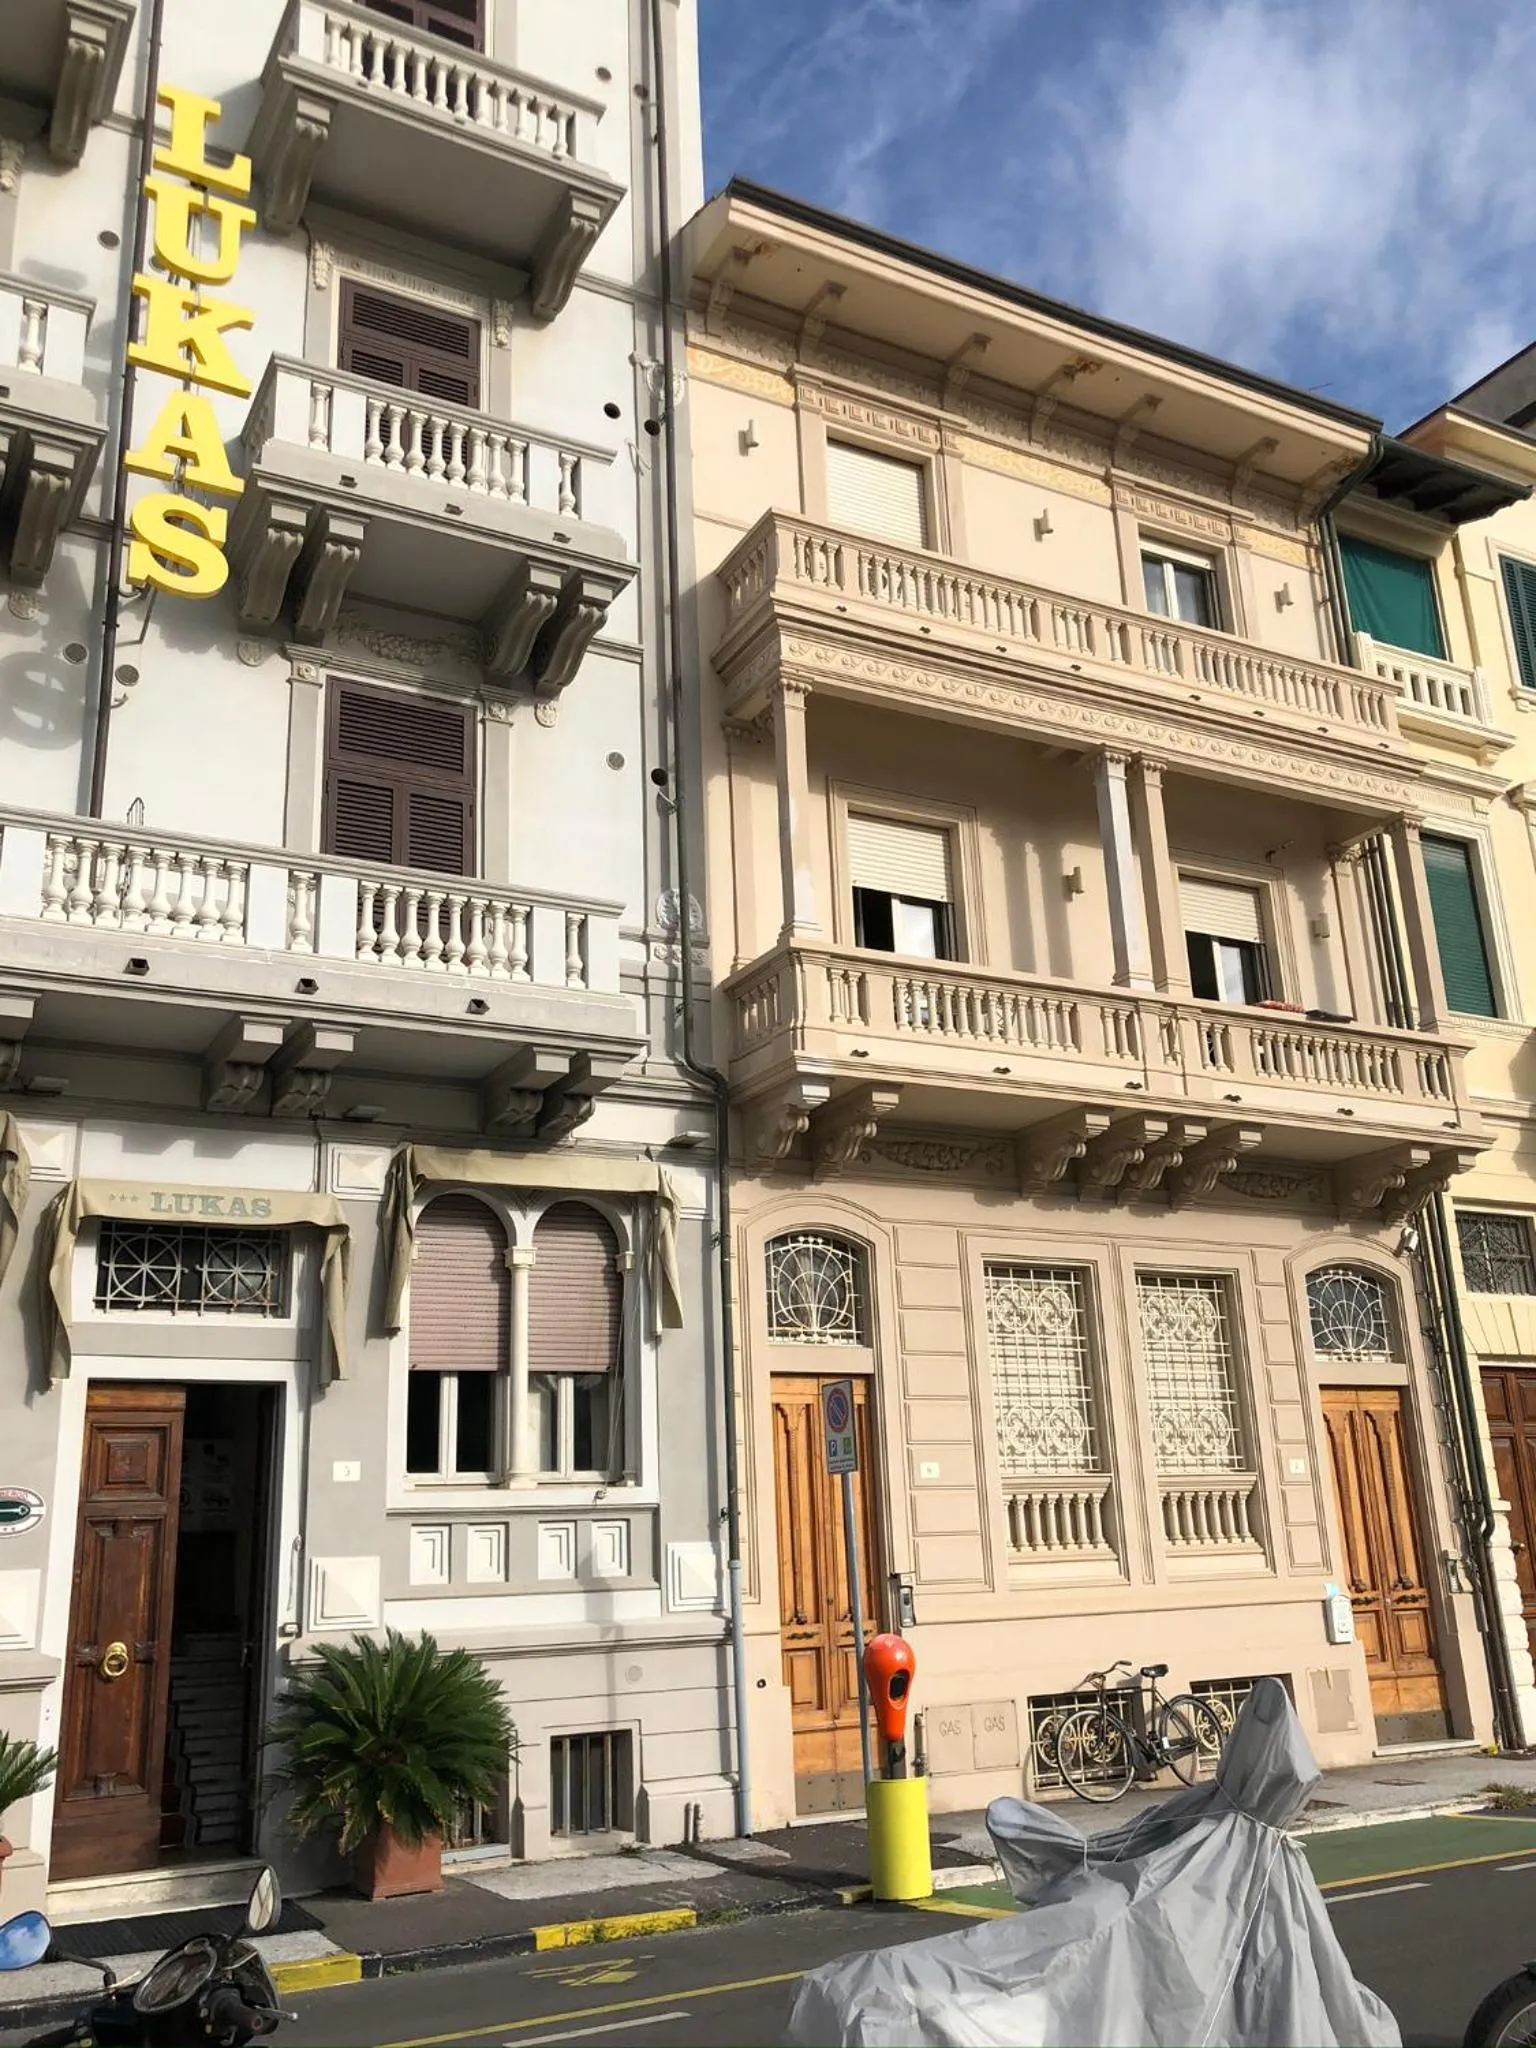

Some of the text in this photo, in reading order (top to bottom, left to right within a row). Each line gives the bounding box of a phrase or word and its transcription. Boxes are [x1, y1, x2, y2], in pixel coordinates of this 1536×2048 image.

[124, 81, 257, 600] LUKAS
[150, 1191, 272, 1219] LUKAS
[939, 1719, 962, 1737] GAS
[984, 1715, 1006, 1733] GAS
